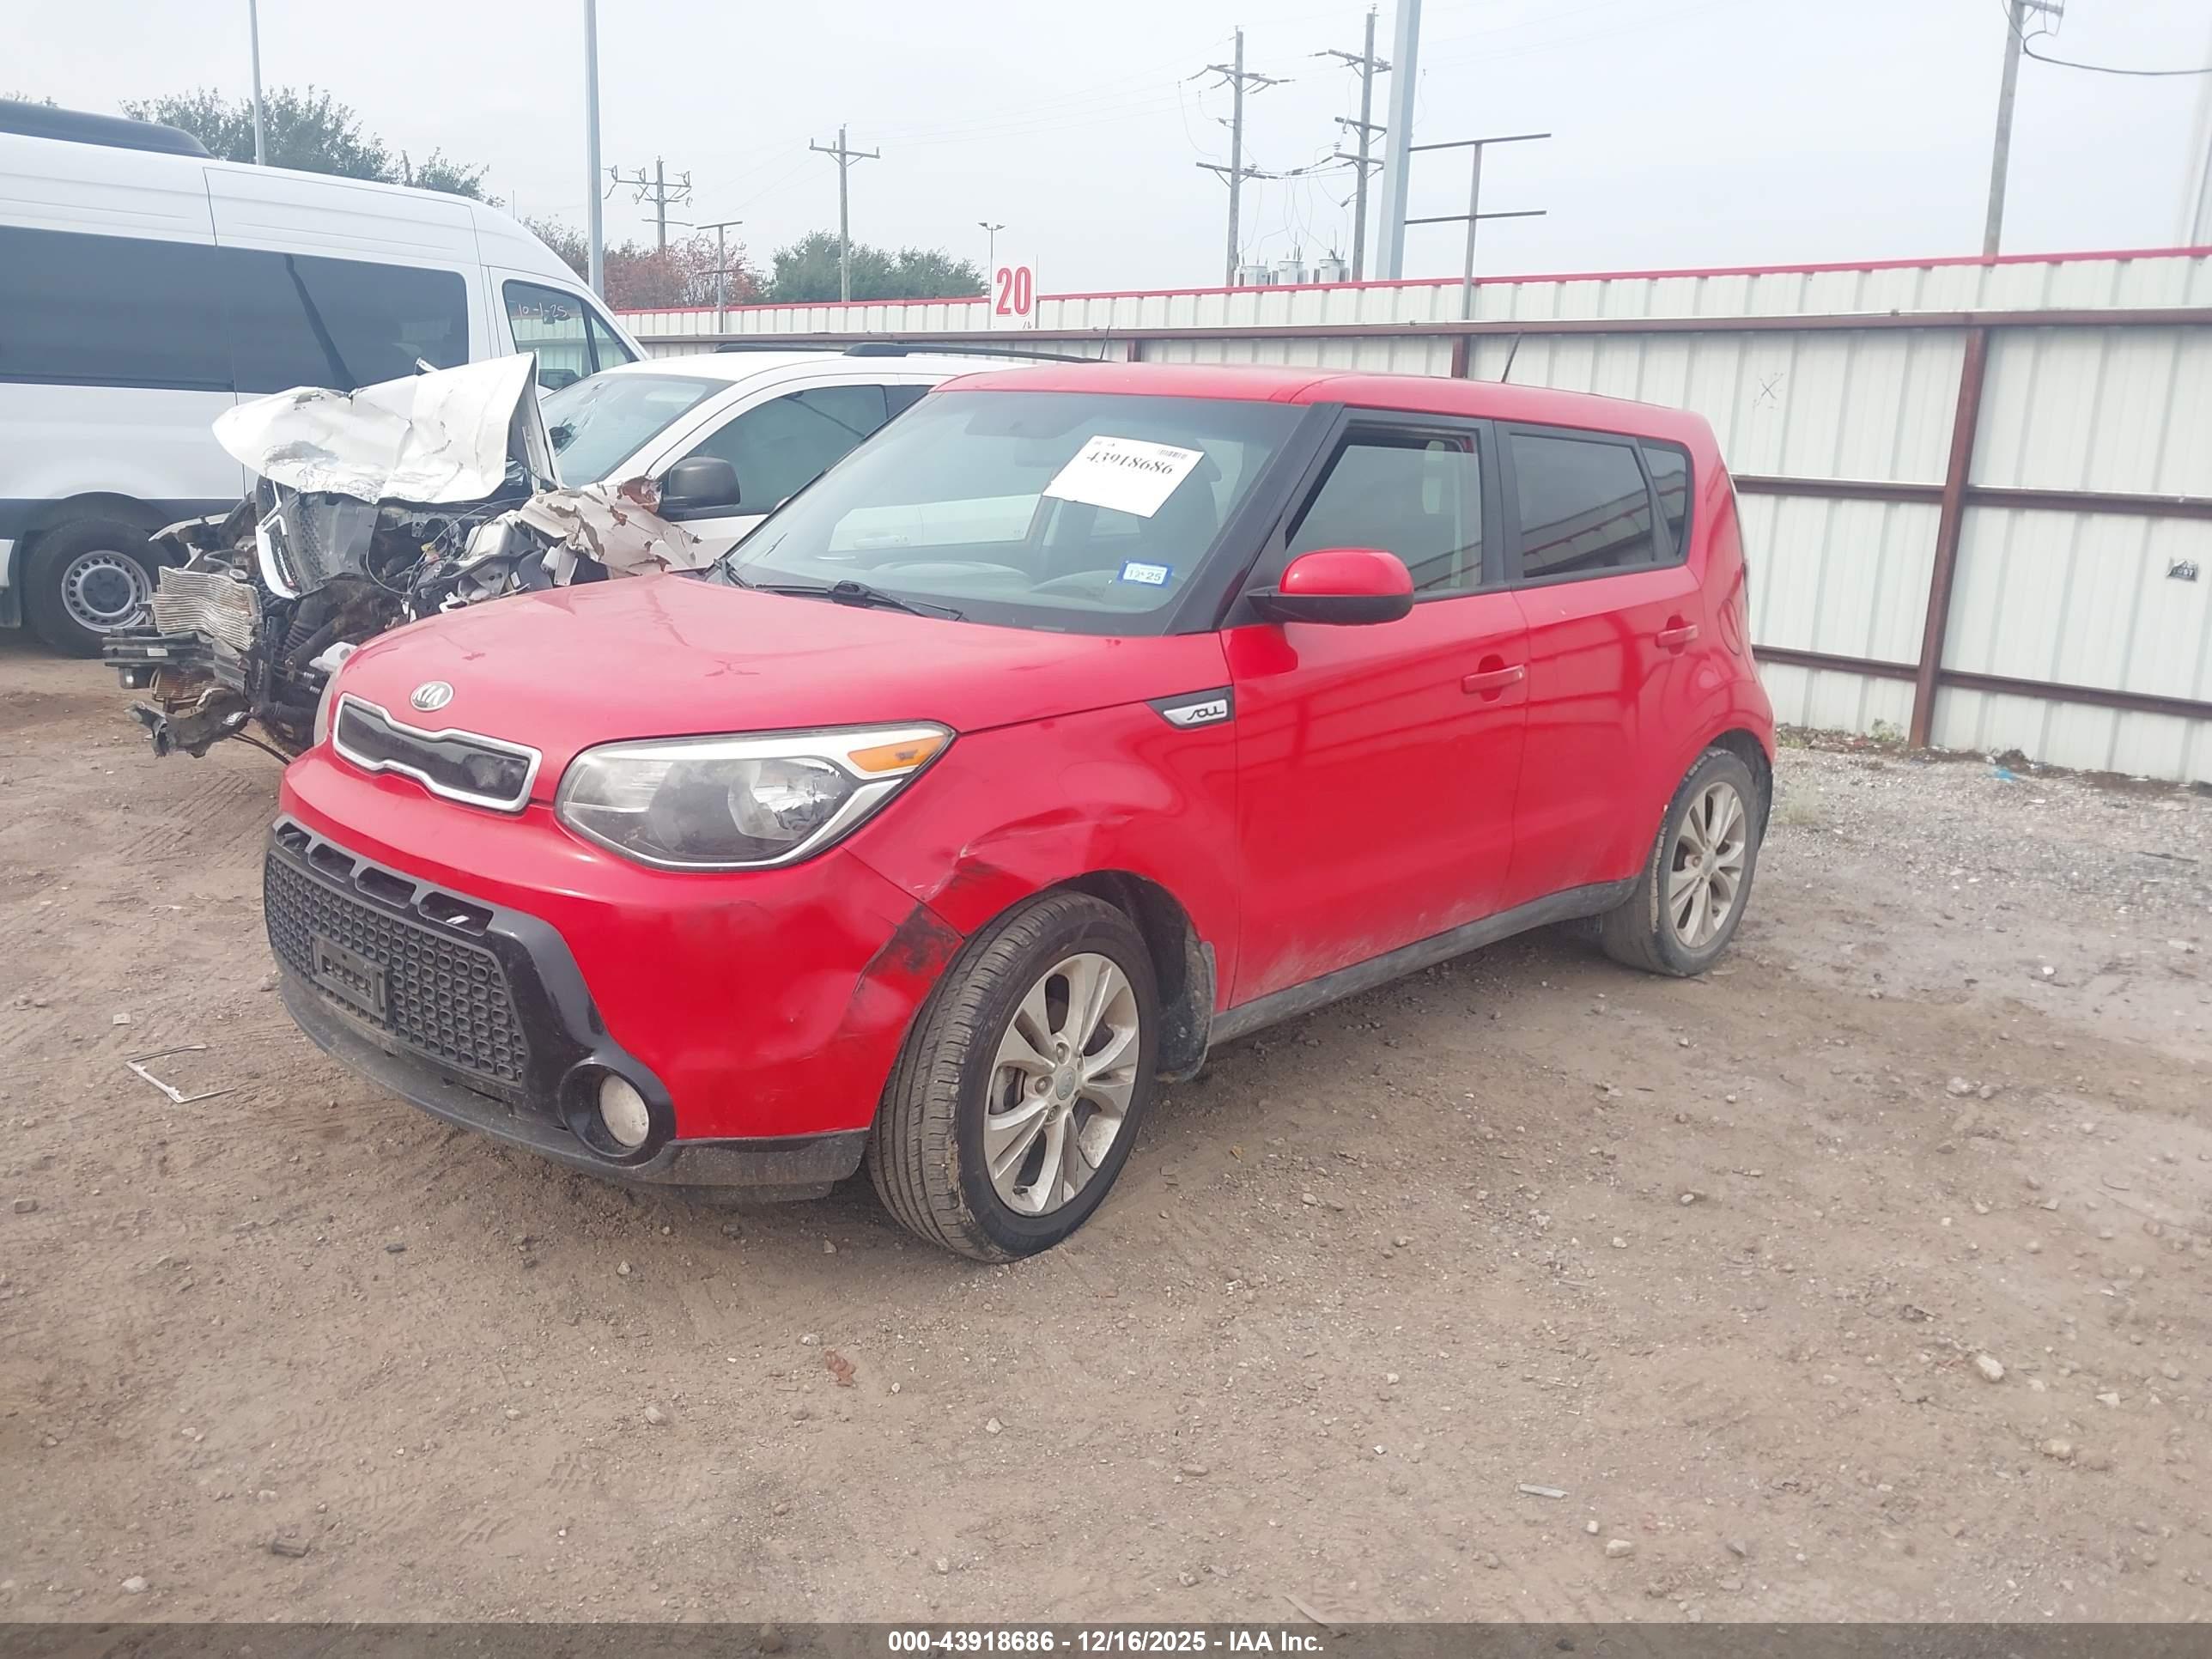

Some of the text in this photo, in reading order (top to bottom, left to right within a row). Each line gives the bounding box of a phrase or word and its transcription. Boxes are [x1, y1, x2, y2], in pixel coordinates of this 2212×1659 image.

[995, 266, 1031, 316] 20
[1086, 451, 1174, 474] 43918686
[412, 685, 445, 706] KIA
